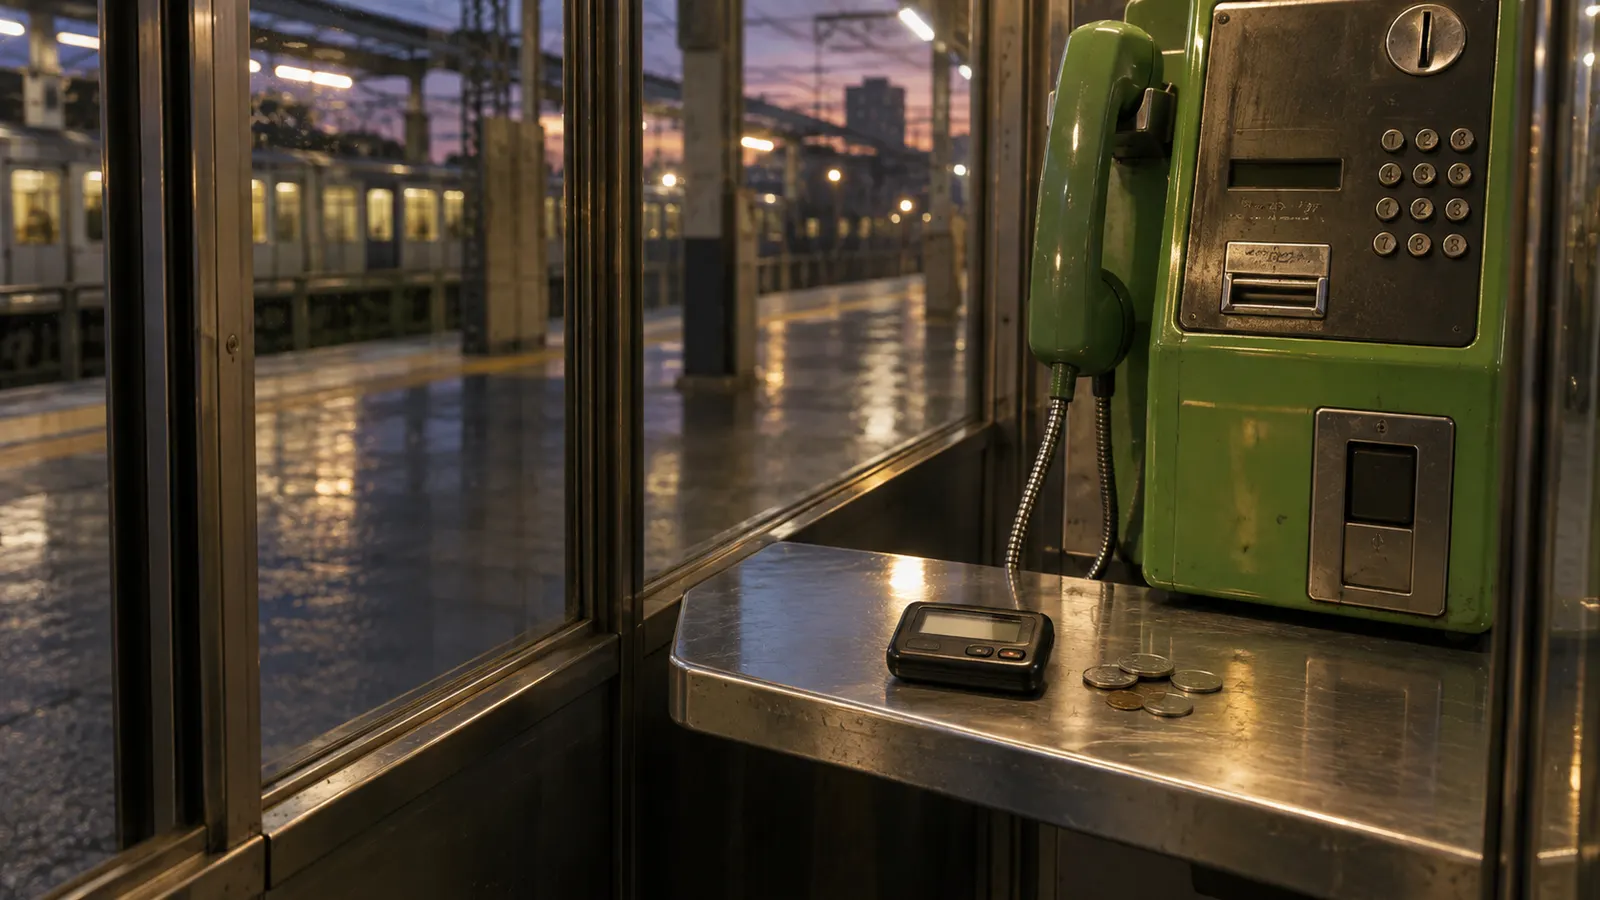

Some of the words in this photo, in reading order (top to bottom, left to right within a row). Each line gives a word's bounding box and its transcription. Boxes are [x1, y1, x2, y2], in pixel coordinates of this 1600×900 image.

[1423, 133, 1431, 146] 2
[1386, 167, 1393, 179] 4
[1417, 202, 1426, 216] 2
[1453, 203, 1461, 216] 3
